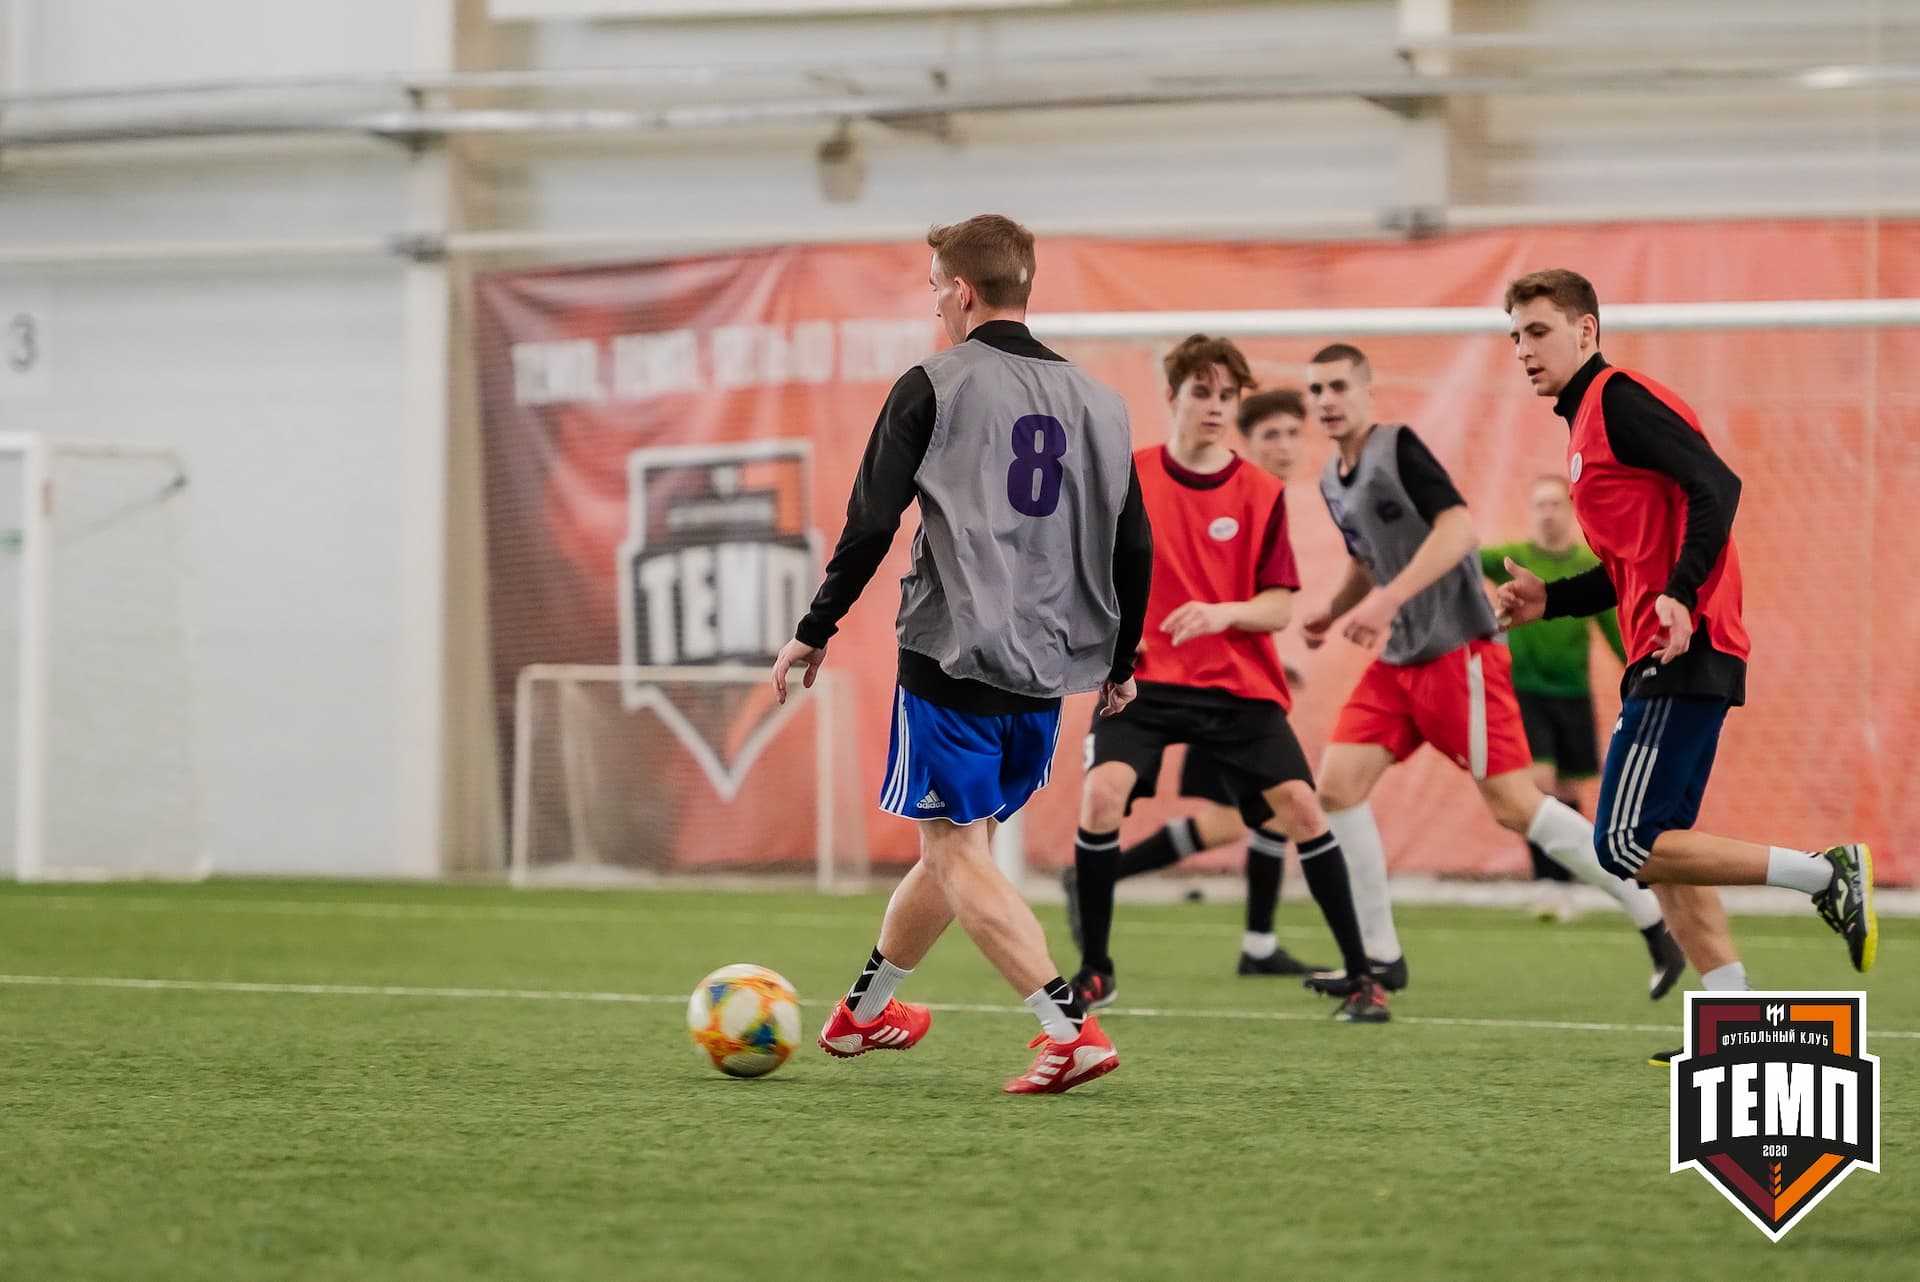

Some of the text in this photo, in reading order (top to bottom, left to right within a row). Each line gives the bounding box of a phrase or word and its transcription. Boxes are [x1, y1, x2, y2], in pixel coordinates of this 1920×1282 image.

[9, 312, 38, 373] 3
[1007, 414, 1067, 517] 8
[916, 801, 946, 809] adidas
